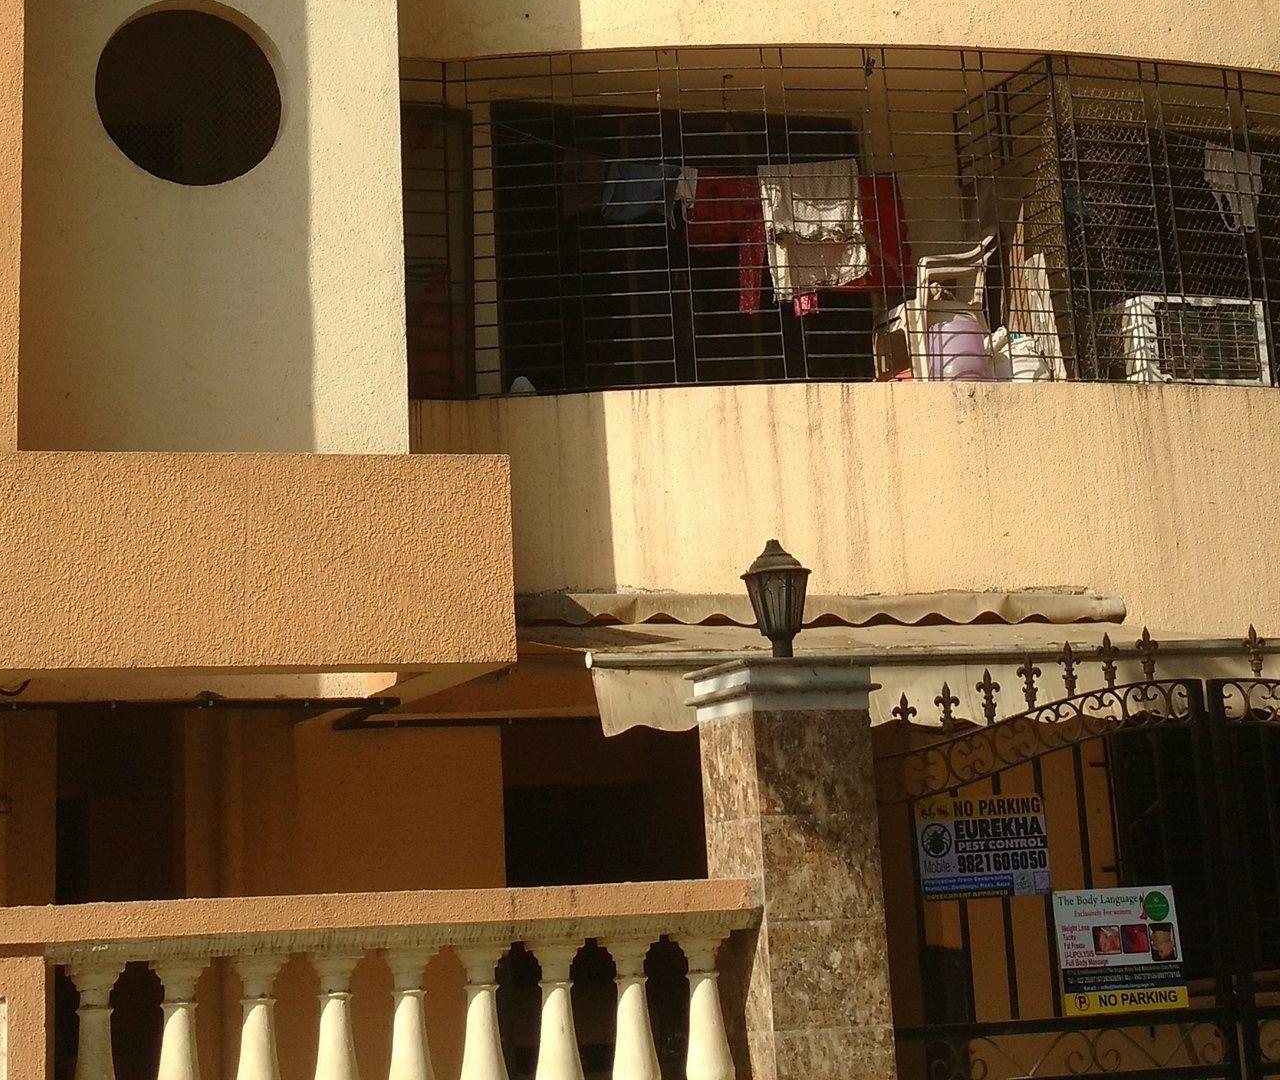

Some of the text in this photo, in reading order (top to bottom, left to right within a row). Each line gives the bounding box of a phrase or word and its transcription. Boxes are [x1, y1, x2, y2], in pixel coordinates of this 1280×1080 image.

[953, 800, 974, 817] NO
[979, 797, 1041, 816] PARKING
[953, 816, 1044, 840] EUREKHA
[959, 837, 1045, 852] PEST CONTROL
[1058, 893, 1139, 909] The Body Language
[1098, 990, 1179, 1008] NO PARKING
